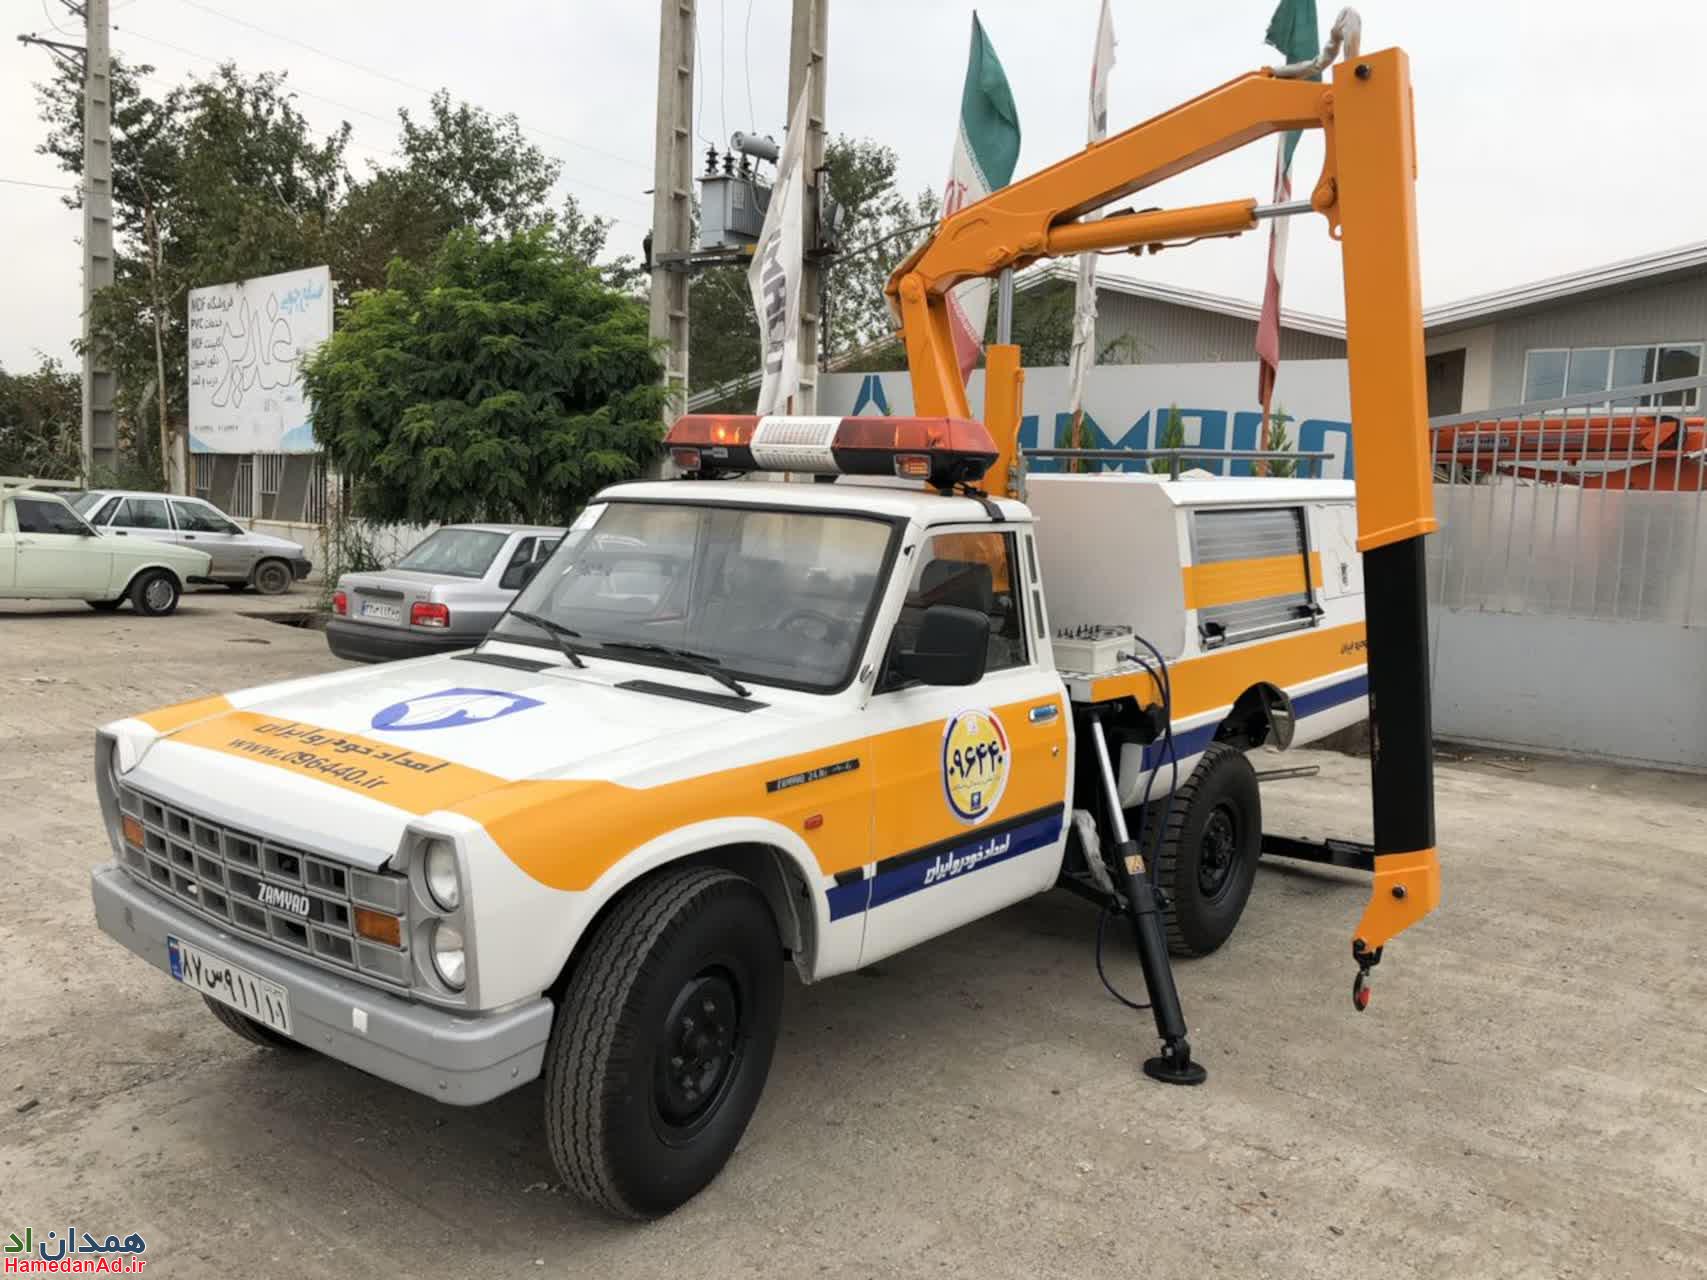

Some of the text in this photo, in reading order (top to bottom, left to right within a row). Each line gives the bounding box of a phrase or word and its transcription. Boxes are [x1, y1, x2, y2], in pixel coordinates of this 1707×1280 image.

[229, 738, 390, 789] www.096440.ir
[254, 723, 450, 774] امداد خودرو ایران
[924, 833, 1011, 885] امداد خودرو ایران
[257, 882, 310, 916] ZAMYAD
